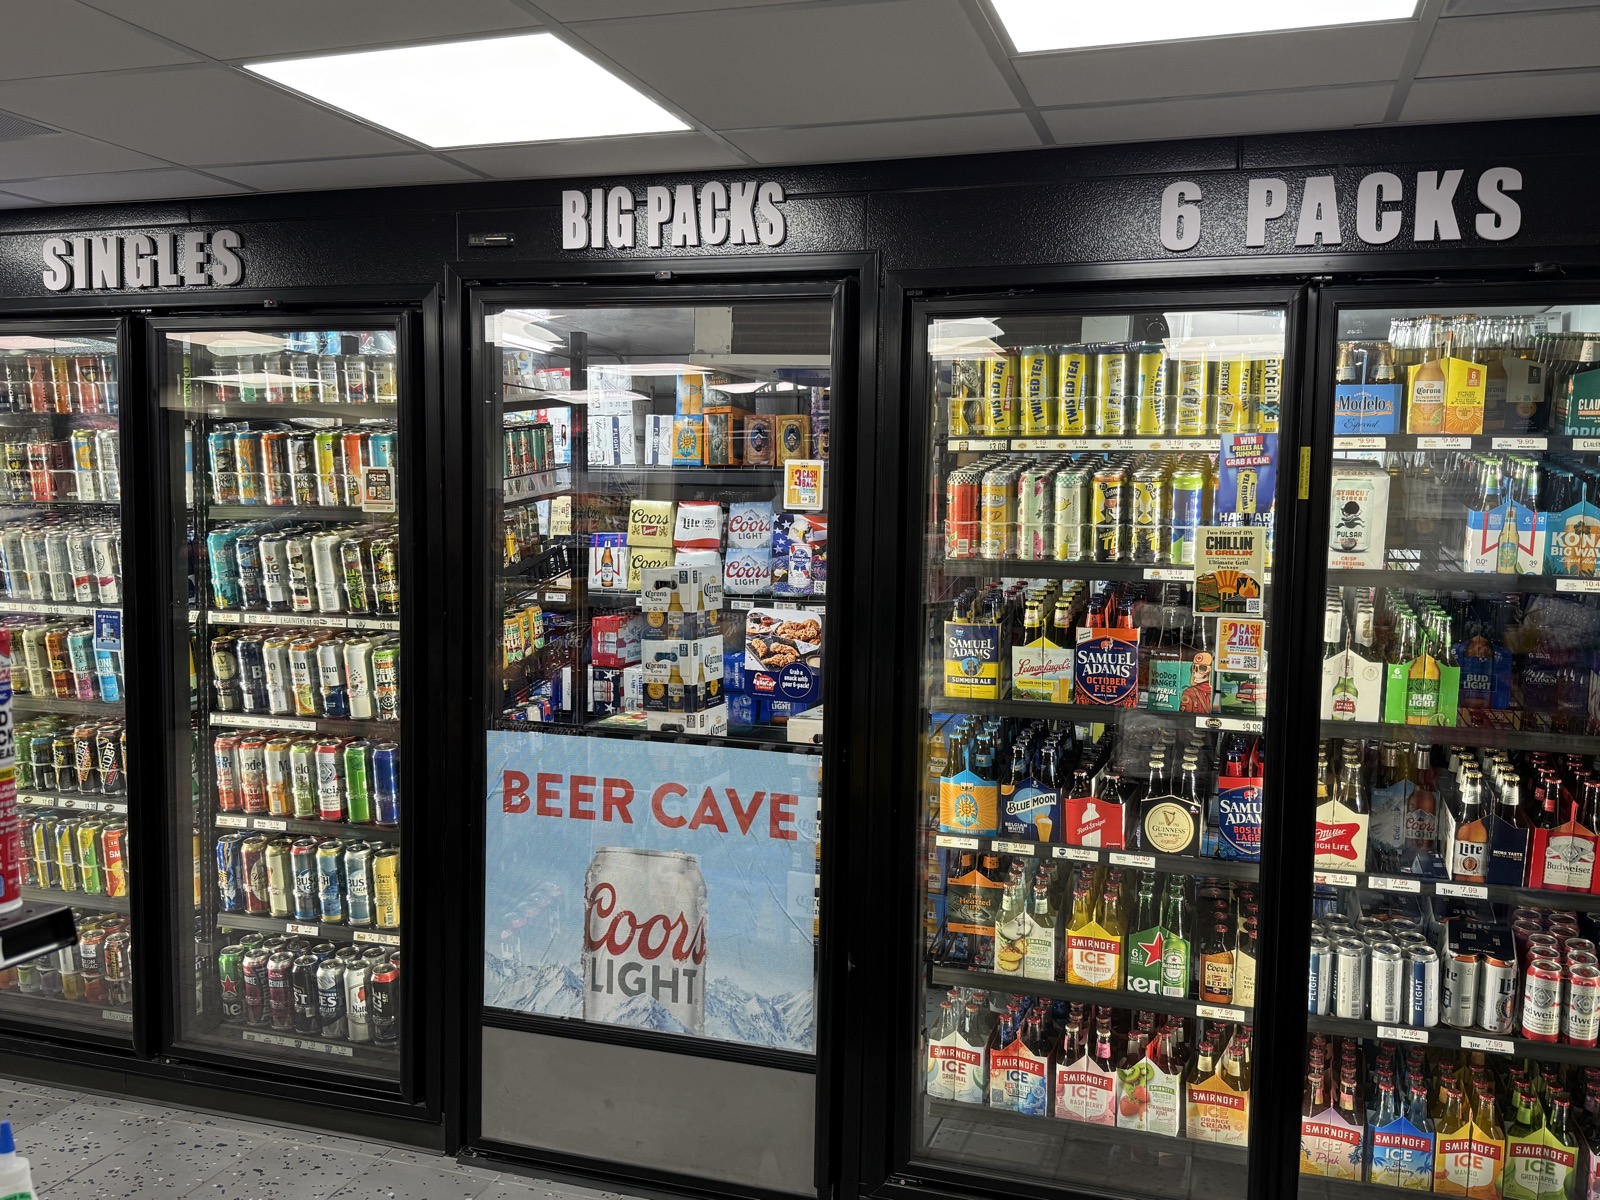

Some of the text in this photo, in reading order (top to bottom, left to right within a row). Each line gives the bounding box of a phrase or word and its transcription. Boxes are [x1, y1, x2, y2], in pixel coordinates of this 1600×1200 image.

[562, 181, 787, 250] BIG PACKS
[1160, 166, 1524, 251] 6 PACKS
[42, 229, 243, 291] SINGLES
[1471, 371, 1477, 380] 6
[991, 362, 1006, 425] TWISTED TEA
[1030, 358, 1045, 422] TWISTED TEA
[1065, 360, 1081, 425] TWISTED TEA
[1416, 385, 1441, 395] Corona
[1339, 395, 1386, 411] Modelo
[1344, 416, 1377, 430] Especial
[1226, 458, 1245, 466] GRAB
[803, 470, 818, 479] CASH
[802, 479, 817, 488] BACK
[1241, 484, 1250, 510] TWISTED
[632, 509, 669, 525] Coors
[682, 518, 701, 529] Lite
[729, 515, 770, 532] Coors
[1206, 536, 1254, 550] CHILLIN'
[1551, 547, 1572, 556] BIG
[726, 561, 770, 578] Coors
[645, 590, 667, 598] Corona
[704, 583, 722, 597] Corona
[1239, 624, 1261, 635] CASH
[949, 637, 995, 650] SAMUEL
[1238, 635, 1260, 647] BACK
[705, 653, 722, 668] Corona
[952, 648, 991, 659] ADAMS
[1077, 650, 1136, 666] SAMUEL
[645, 662, 667, 671] Corona
[1014, 658, 1071, 677] Leinenkugel's
[1081, 663, 1130, 678] ADAMS
[1086, 676, 1127, 686] OCTOBER
[1151, 670, 1177, 680] VOODOO
[1466, 674, 1489, 682] BUD
[1094, 685, 1118, 693] FEST
[1150, 679, 1177, 688] RANGER
[1463, 681, 1491, 690] LIGHT
[1150, 687, 1177, 696] IMPERIAL
[1155, 694, 1169, 703] IPA
[1408, 699, 1436, 707] LIGHT
[711, 723, 727, 736] Corona
[502, 770, 799, 841] BEER CAVE
[1006, 794, 1056, 814] BLUE MOON
[1076, 817, 1107, 835] Red Stripe
[1152, 825, 1186, 834] GUINNESS
[1405, 817, 1435, 831] Coors
[1318, 828, 1347, 839] Miller
[1407, 830, 1433, 838] LIGHT
[1332, 842, 1351, 851] LIFE
[1459, 843, 1482, 855] Lite
[1547, 862, 1591, 874] Budweiser
[959, 898, 991, 907] Hearted
[584, 882, 706, 965] Coors
[1071, 938, 1116, 951] SMIRNOFF
[1080, 951, 1107, 965] ICE
[1131, 948, 1138, 958] 6
[1076, 963, 1111, 973] SCREWDRIVER
[1206, 962, 1228, 973] Coors
[591, 956, 698, 1005] LIGHT
[1206, 980, 1228, 988] BEER
[1309, 971, 1318, 1001] FLIGHT
[1415, 979, 1423, 1011] FLIGHT
[934, 1047, 976, 1062] SMIRNOFF
[942, 1061, 967, 1075] ICE
[996, 1058, 1039, 1072] SMIRNOFF
[942, 1074, 967, 1083] ORIGINAL
[1006, 1070, 1028, 1084] ICE
[1063, 1073, 1108, 1087] SMIRNOFF
[1071, 1085, 1098, 1100] ICE
[1193, 1091, 1239, 1106] SMIRNOFF
[1069, 1098, 1103, 1109] RASPBERRY
[1203, 1105, 1229, 1119] ICE
[1200, 1117, 1230, 1125] ORANGE
[1200, 1121, 1231, 1131] CREAM
[1305, 1124, 1355, 1141] SMIRNOFF
[1315, 1138, 1342, 1154] ICE
[1375, 1134, 1426, 1149] SMIRNOFF
[1445, 1140, 1496, 1156] SMIRNOFF
[1315, 1152, 1340, 1164] Pink
[1385, 1148, 1413, 1162] ICE
[1515, 1145, 1569, 1162] SMIRNOFF
[1391, 1161, 1407, 1169] Blue
[1453, 1154, 1483, 1170] ICE
[1525, 1158, 1556, 1175] ICE
[1383, 1164, 1415, 1178] Raspberry
[1454, 1169, 1478, 1177] MANGO
[1520, 1173, 1559, 1185] GREEN APPLE
